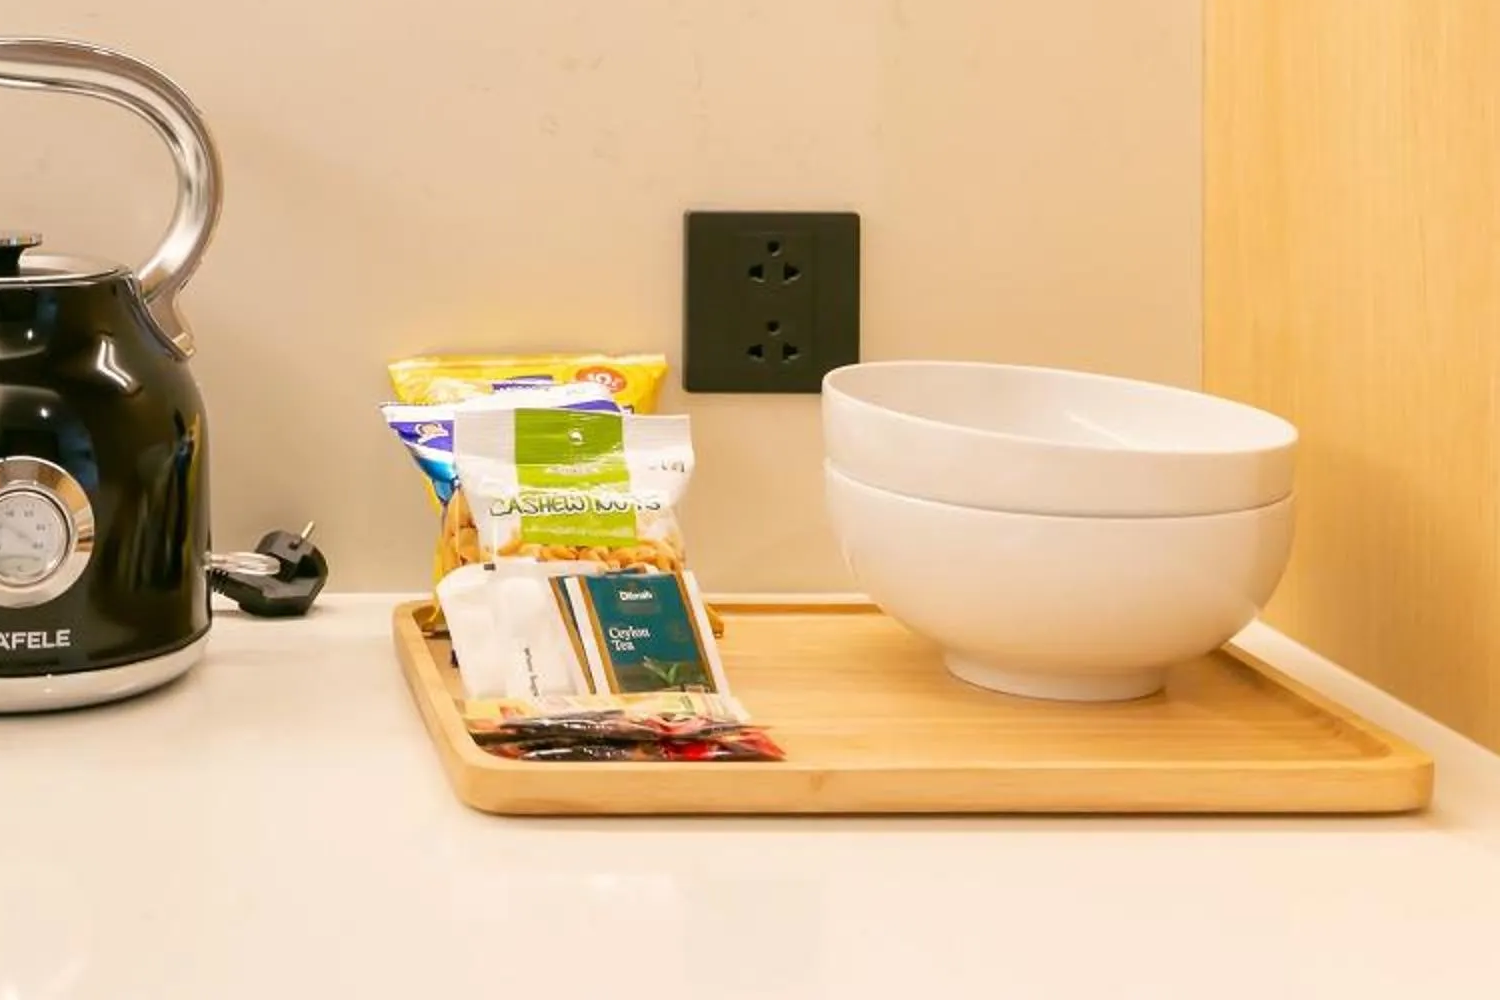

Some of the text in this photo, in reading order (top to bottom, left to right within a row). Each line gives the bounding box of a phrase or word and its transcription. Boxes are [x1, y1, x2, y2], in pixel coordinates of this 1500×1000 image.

[489, 494, 586, 517] CASHEW
[609, 626, 651, 640] Ceylon
[611, 640, 635, 651] Tea
